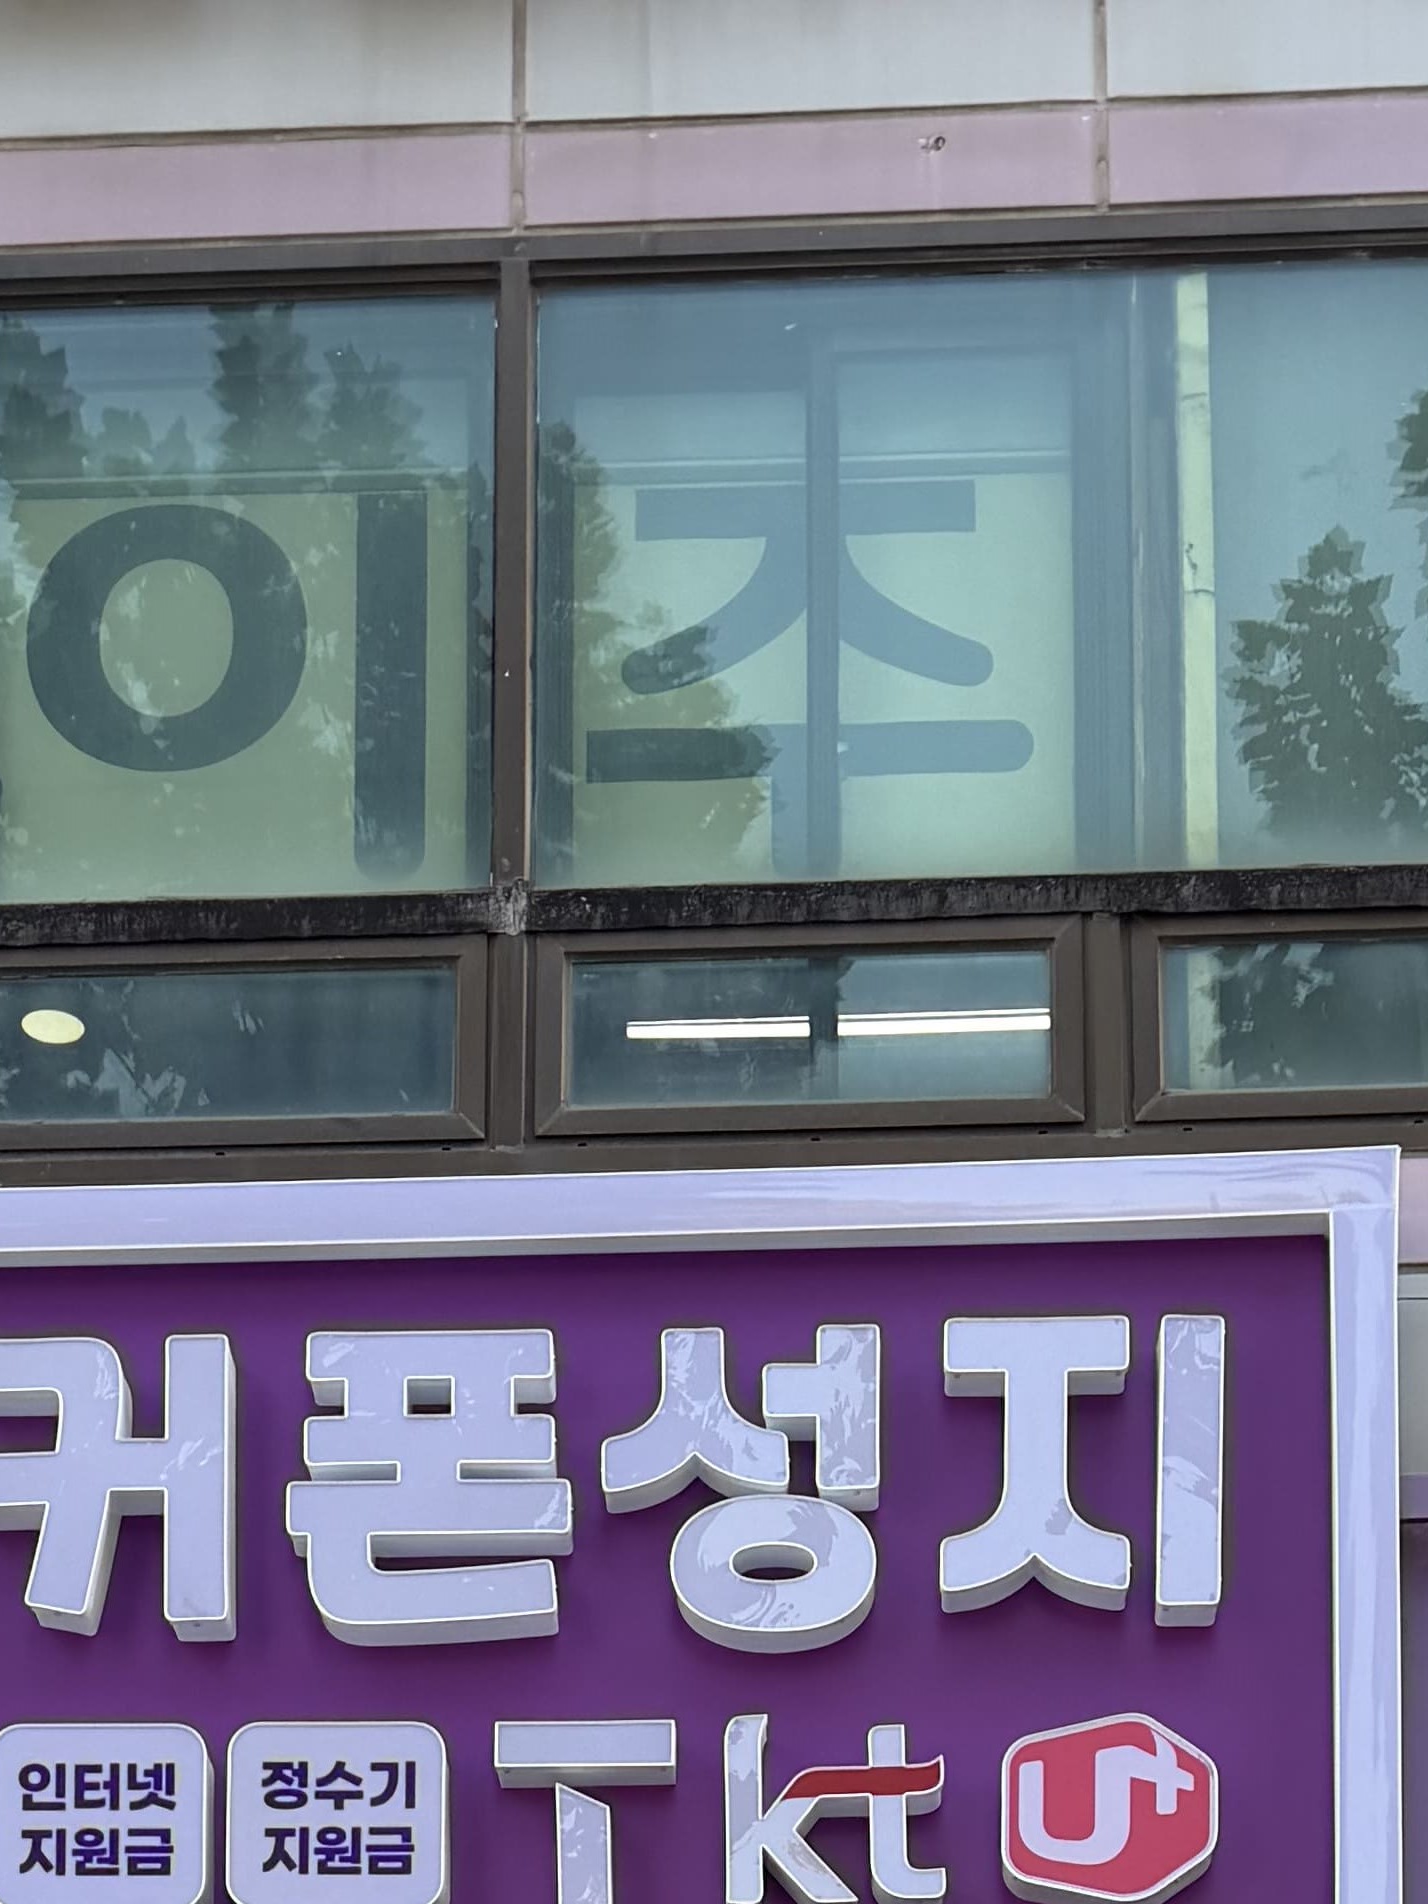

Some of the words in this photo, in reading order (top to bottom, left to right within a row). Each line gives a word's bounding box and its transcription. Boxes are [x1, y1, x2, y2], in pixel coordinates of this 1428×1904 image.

[17, 1762, 177, 1814] 인터넷
[261, 1761, 417, 1813] 정수기
[19, 1830, 174, 1879] 지원금
[261, 1826, 416, 1877] 지원금
